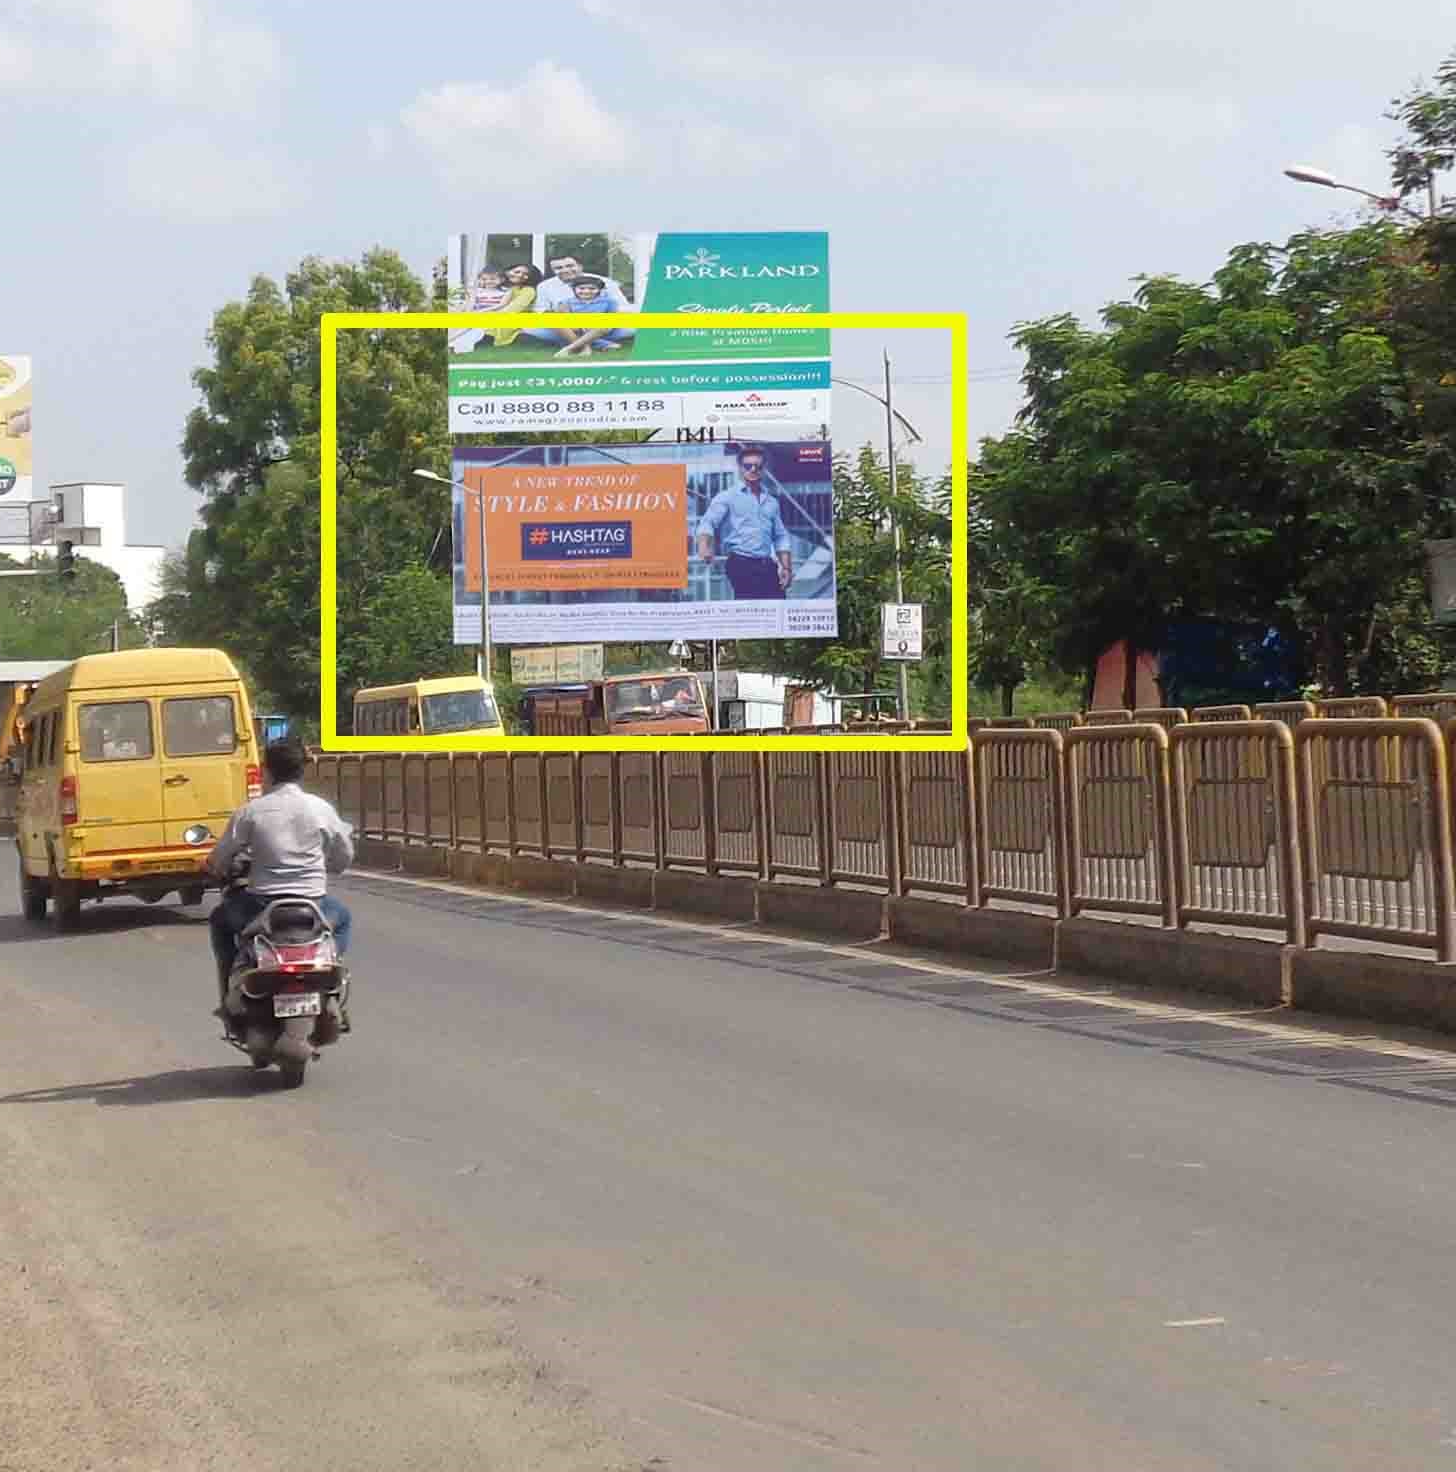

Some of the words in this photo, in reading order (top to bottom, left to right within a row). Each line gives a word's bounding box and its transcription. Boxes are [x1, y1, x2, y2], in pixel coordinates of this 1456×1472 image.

[664, 264, 820, 280] PARKLAND
[671, 373, 721, 386] before
[457, 402, 495, 416] Call
[501, 401, 560, 415] 8880
[566, 400, 596, 414] 88
[605, 400, 629, 413] 11
[636, 399, 665, 412] 88
[511, 476, 521, 488] A
[526, 476, 560, 488] NEW
[565, 474, 616, 488] TREND
[618, 474, 642, 486] OF
[473, 494, 550, 513] STYLE
[573, 492, 680, 512] FASHION
